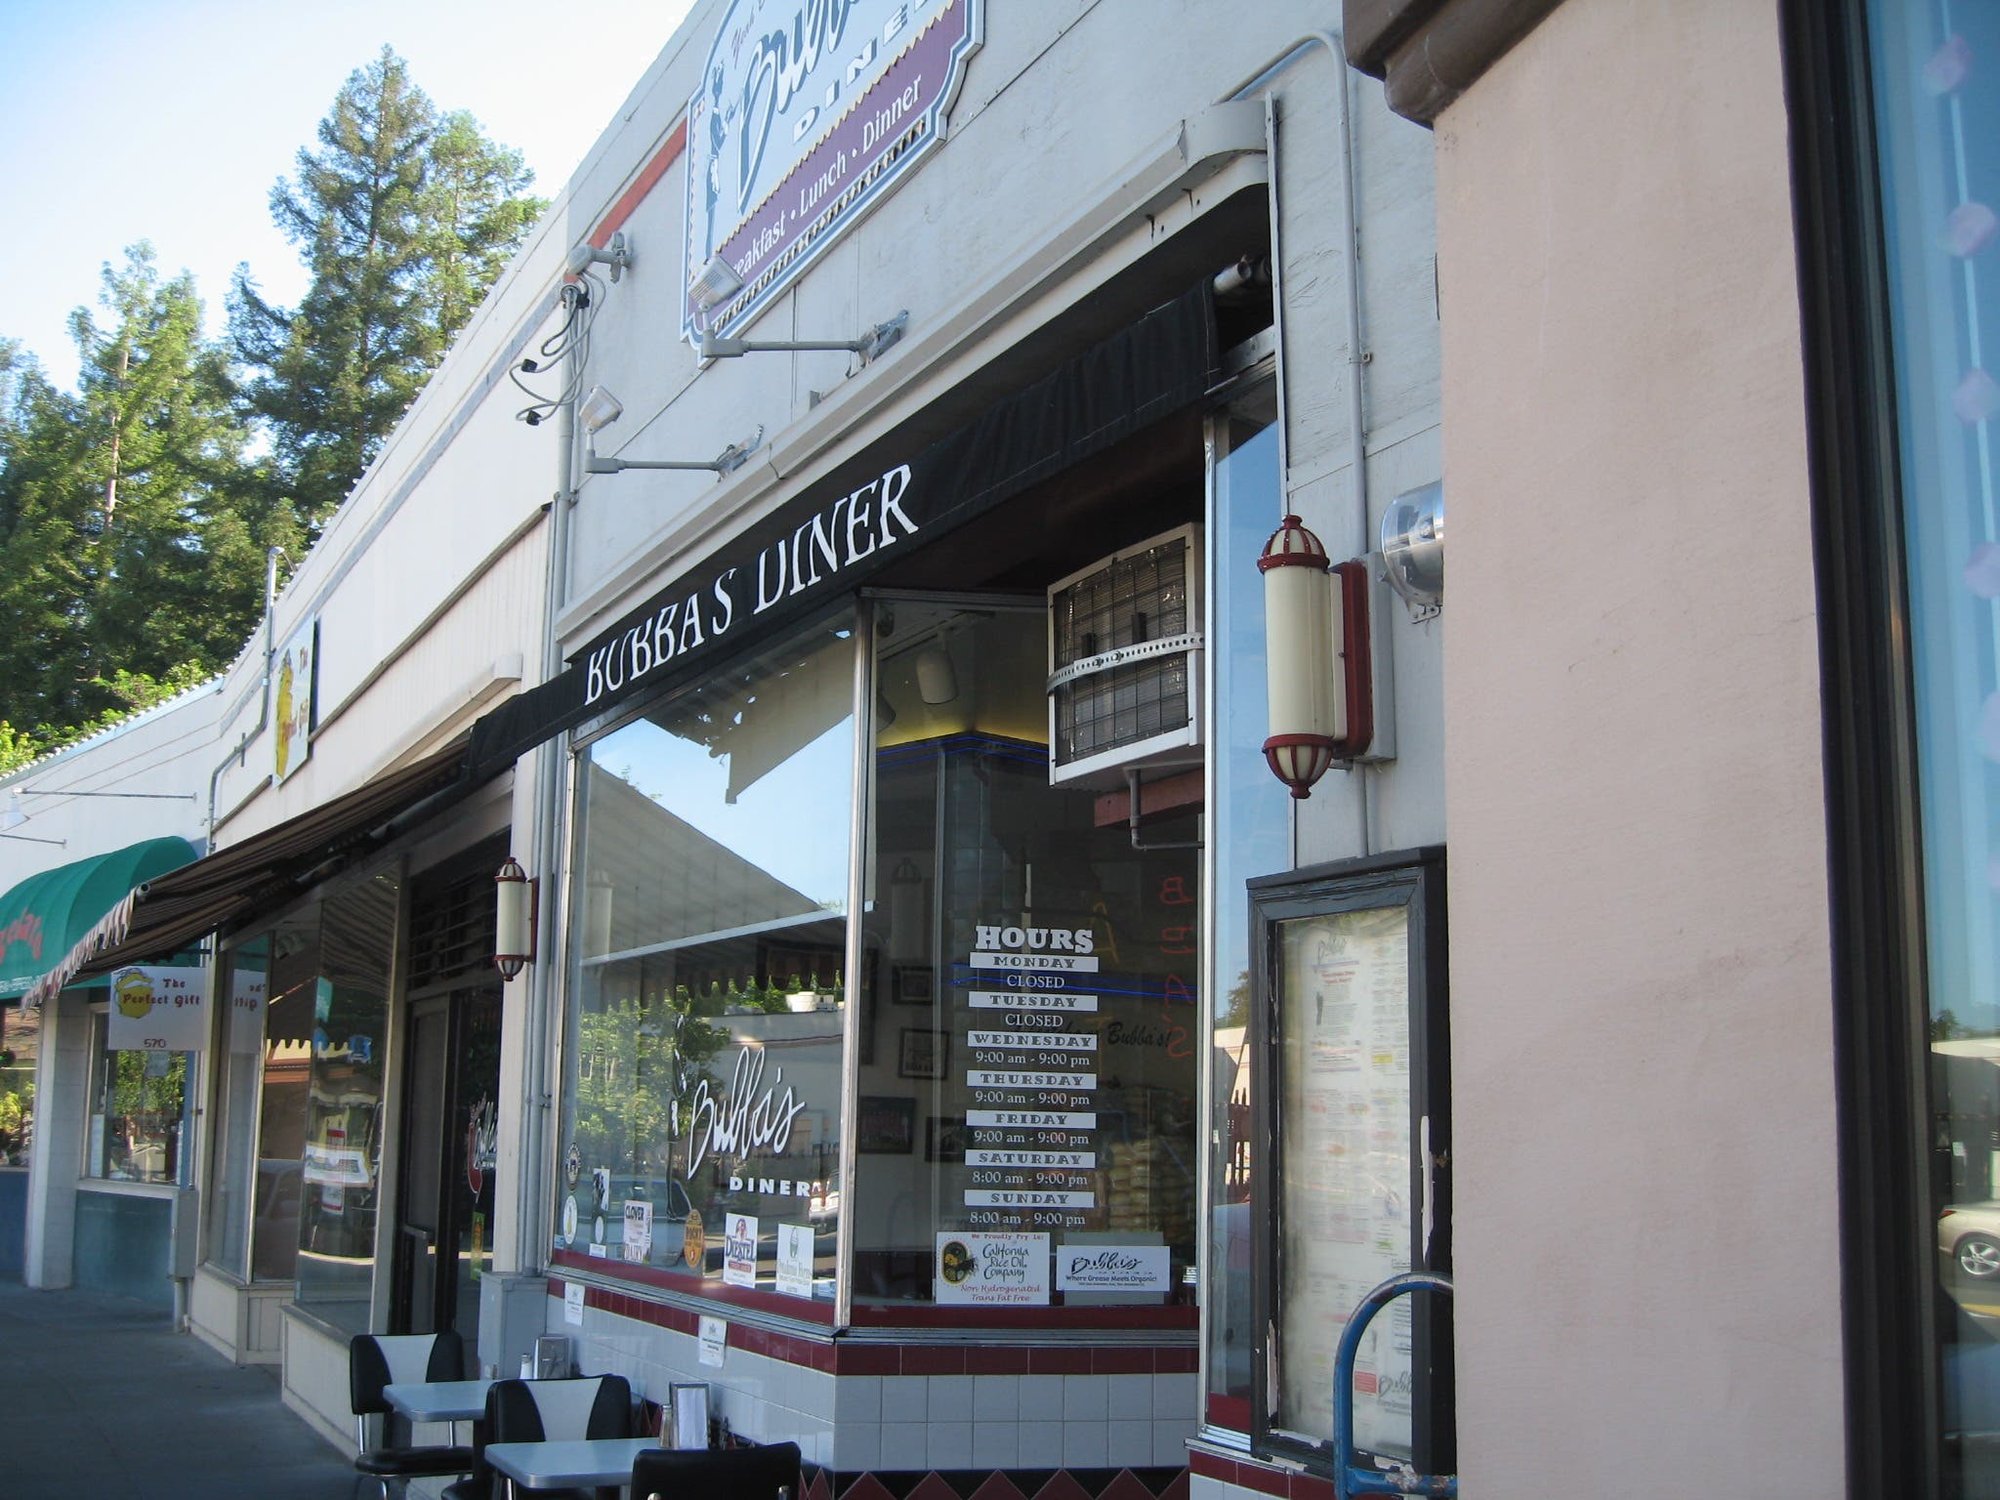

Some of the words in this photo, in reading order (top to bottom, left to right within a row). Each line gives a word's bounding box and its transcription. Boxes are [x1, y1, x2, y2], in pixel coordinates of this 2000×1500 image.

[792, 0, 932, 144] DINE
[799, 153, 847, 217] Lunch
[862, 73, 922, 154] Dinner
[752, 463, 920, 615] DINER
[974, 925, 1094, 954] HOURS
[992, 956, 1076, 969] MONDAY
[162, 978, 186, 989] The
[1006, 974, 1065, 989] CLOSED
[122, 994, 169, 1005] Perfect
[174, 994, 200, 1008] Gift
[989, 995, 1078, 1008] TUESDAY
[1005, 1014, 1064, 1027] CLOSED
[973, 1033, 1092, 1047] WEDNESDAY
[975, 1051, 1004, 1064] 9:00
[1007, 1054, 1026, 1064] am
[1038, 1052, 1067, 1065] 9:00
[1070, 1055, 1090, 1068] pm
[979, 1073, 1085, 1086] THURSDAY
[975, 1090, 1004, 1103] 9:00
[1007, 1094, 1026, 1103] am
[1038, 1092, 1067, 1105] 9:00
[1070, 1095, 1090, 1108] pm
[687, 1046, 806, 1181] Bubba's
[995, 1113, 1068, 1125] FRIDAY
[974, 1130, 1003, 1142] 9:00
[1006, 1133, 1025, 1143] am
[1037, 1131, 1066, 1144] 9:00
[1069, 1135, 1089, 1147] pm
[978, 1152, 1082, 1165] SATURDAY
[729, 1176, 811, 1197] DINER
[972, 1171, 1001, 1184] 8:00
[1004, 1175, 1024, 1184] am
[1036, 1172, 1065, 1185] 9:00
[1068, 1175, 1088, 1188] pm
[990, 1193, 1070, 1204] SUNDAY
[969, 1212, 999, 1225] 8:00
[1002, 1215, 1022, 1225] am
[1033, 1213, 1062, 1225] 9:00
[1066, 1216, 1086, 1229] pm
[982, 1243, 1030, 1259] California
[989, 1257, 1009, 1268] Rice
[983, 1265, 1025, 1284] Company
